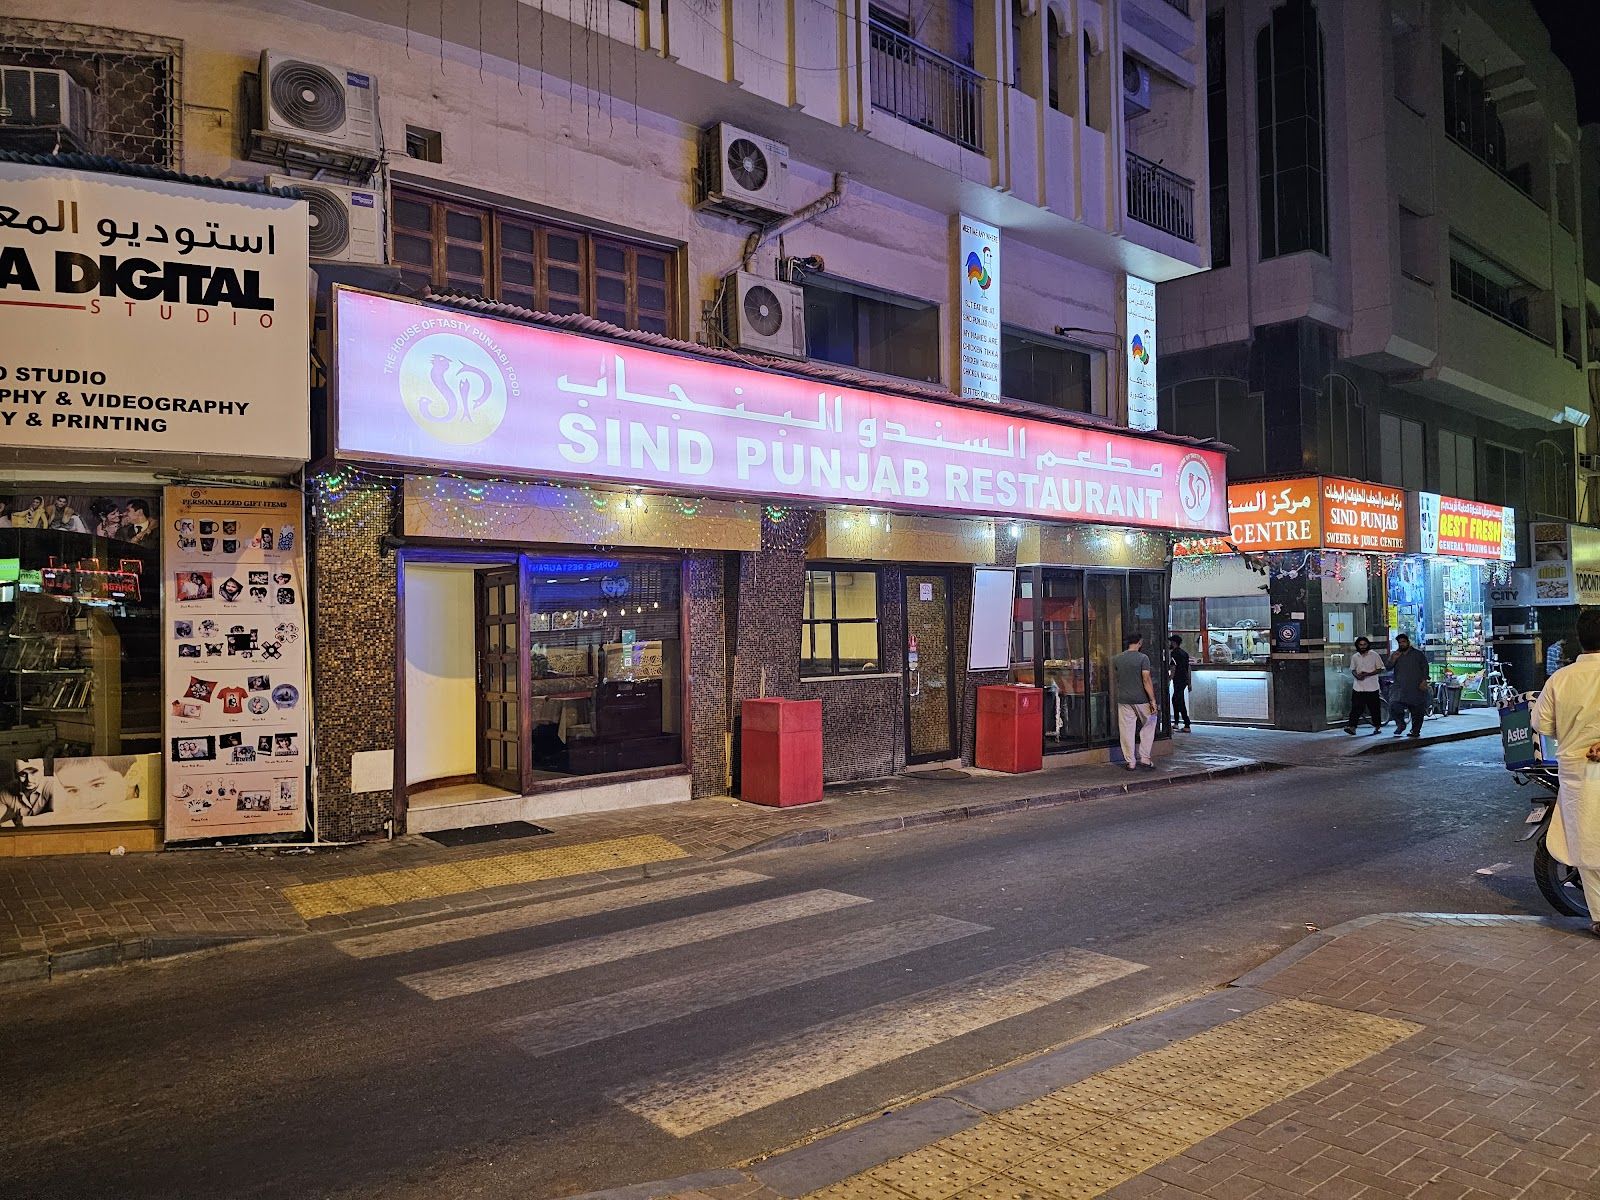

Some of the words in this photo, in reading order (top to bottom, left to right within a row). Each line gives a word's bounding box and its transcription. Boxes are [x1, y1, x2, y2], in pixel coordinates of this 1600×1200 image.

[97, 216, 275, 256] استوديو
[0, 246, 41, 292] A
[55, 250, 275, 312] DIGITAL
[91, 299, 273, 329] STUDIO
[383, 353, 397, 376] THE
[393, 321, 422, 354] HOUSE
[420, 317, 438, 331] OF
[436, 317, 473, 334] TASTY
[470, 325, 511, 369] PUNJABI
[505, 365, 522, 398] FOOD
[16, 367, 107, 386] STUDIO
[0, 389, 47, 405] PHY
[56, 391, 72, 407] &
[81, 392, 250, 416] VIDEOGRAPHY
[0, 411, 18, 427] Y
[25, 411, 43, 427] &
[52, 413, 168, 433] PRINTING
[556, 411, 714, 477] SIND
[736, 435, 931, 498] PUNJAB
[944, 462, 1164, 521] RESTAURANT
[1036, 440, 1163, 478] مطعم
[182, 498, 242, 507] PERSONALIZED
[243, 500, 261, 508] GIFT
[262, 501, 288, 509] ITEMS
[1228, 489, 1267, 514] السن
[1268, 487, 1311, 516] مركز
[1230, 519, 1312, 545] CENTRE
[1330, 506, 1358, 528] SIND
[1360, 511, 1399, 533] PUNJAB
[1439, 513, 1469, 538] BEST
[1469, 517, 1502, 543] FRESH
[1326, 531, 1351, 545] SWEETS
[1352, 535, 1359, 546] &
[1360, 536, 1379, 548] JUICE
[1380, 536, 1404, 549] CENTRE
[1439, 539, 1465, 552] GENERAL
[1465, 542, 1488, 555] TRADING
[1490, 590, 1519, 601] CITY
[1575, 572, 1600, 593] TORONT
[1507, 727, 1529, 743] Aster
